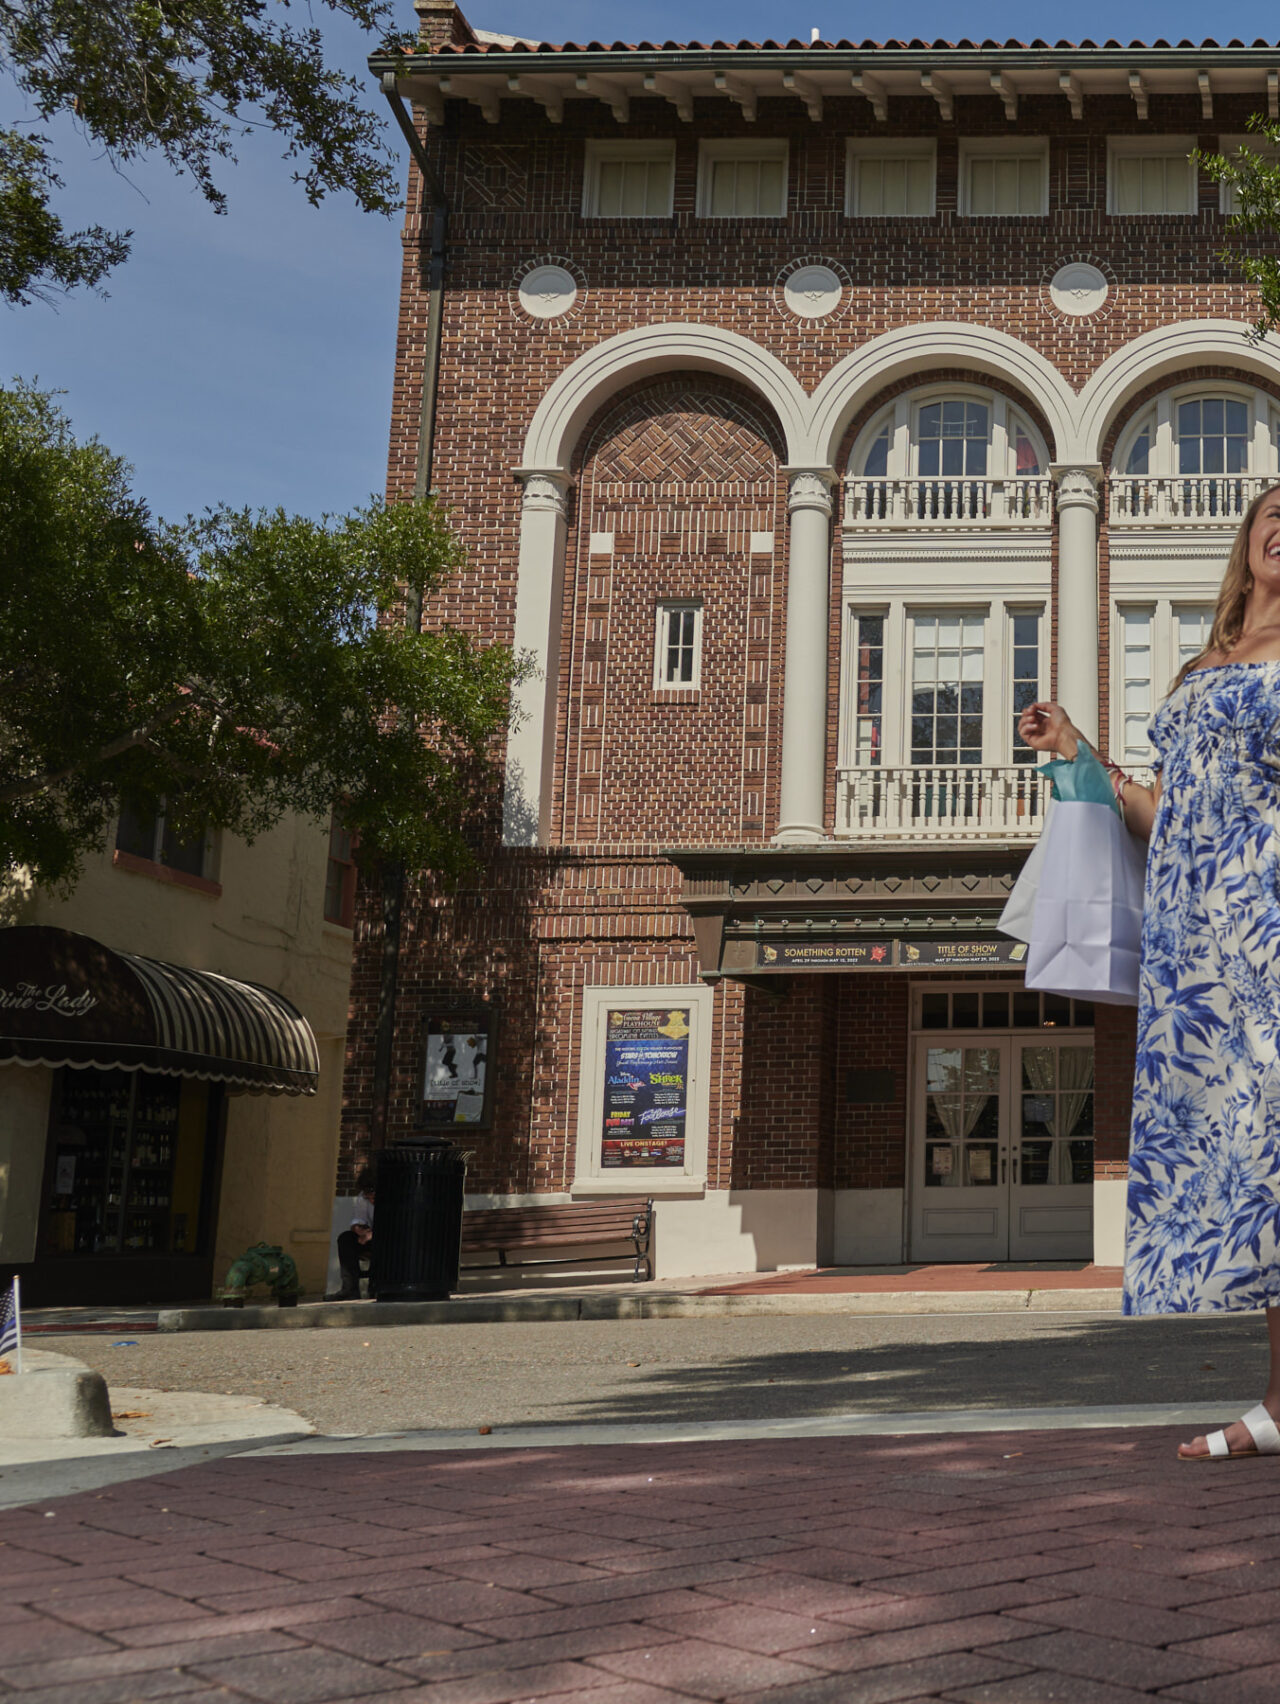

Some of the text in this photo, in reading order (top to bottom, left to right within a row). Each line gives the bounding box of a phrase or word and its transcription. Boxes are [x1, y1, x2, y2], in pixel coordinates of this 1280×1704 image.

[784, 947, 867, 957] SOMETHING ROTTEN
[937, 944, 998, 954] TITLE OF SHOW
[16, 982, 43, 997] The
[35, 984, 100, 1017] Lady
[608, 1074, 640, 1085] Aladdin
[638, 1107, 686, 1125] Footloose
